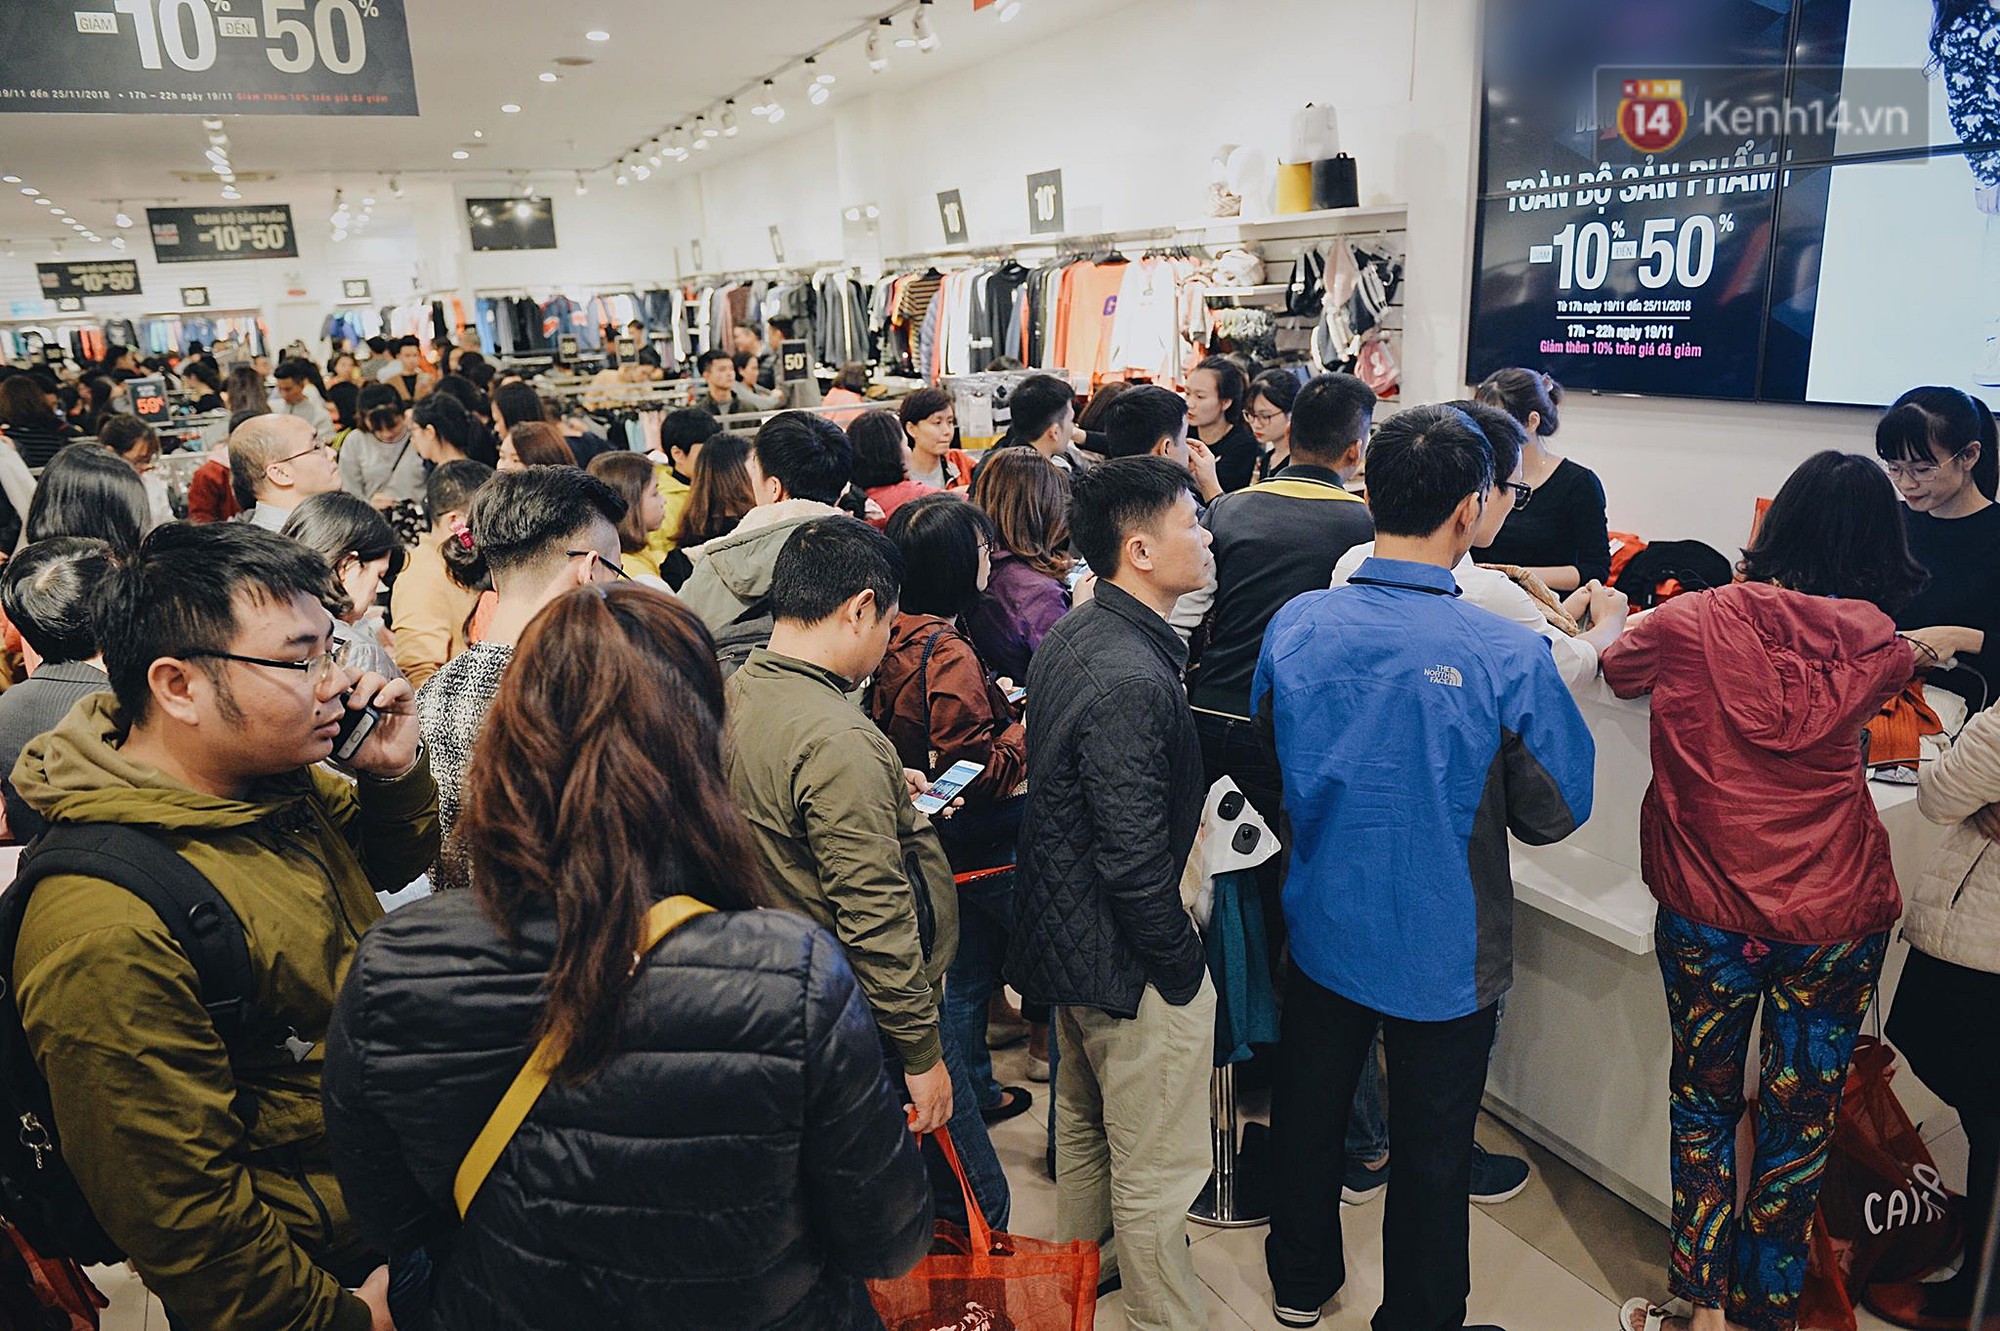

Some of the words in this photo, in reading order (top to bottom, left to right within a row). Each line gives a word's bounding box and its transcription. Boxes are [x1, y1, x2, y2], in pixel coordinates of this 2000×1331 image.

[52, 88, 110, 99] 25/11/2018
[129, 90, 147, 100] 17h
[160, 91, 178, 100] 22h
[206, 91, 233, 100] 19/11
[1506, 169, 1570, 212] TOÀN
[1576, 161, 1614, 214] BỘ
[1619, 154, 1679, 203] SẢN
[1638, 213, 1734, 289] 50%
[1568, 300, 1582, 312] 17h
[1583, 300, 1602, 313] ngày
[1603, 300, 1625, 312] 19/11
[1626, 299, 1642, 312] đến
[1643, 300, 1691, 312] 25/11/2018
[1567, 324, 1585, 338] 17h
[1595, 324, 1615, 338] 22h
[1616, 324, 1642, 341] ngày
[1643, 325, 1674, 339] 19/11
[1540, 339, 1563, 353] Giảm
[1565, 340, 1589, 354] thêm
[1592, 341, 1613, 355] 10%
[1616, 340, 1635, 355] trên
[1638, 341, 1654, 358] giá
[1657, 342, 1671, 356] đã
[1674, 341, 1702, 359] giảm
[1423, 668, 1450, 680] NORTH
[1435, 664, 1451, 673] THE
[1429, 676, 1450, 685] FACE
